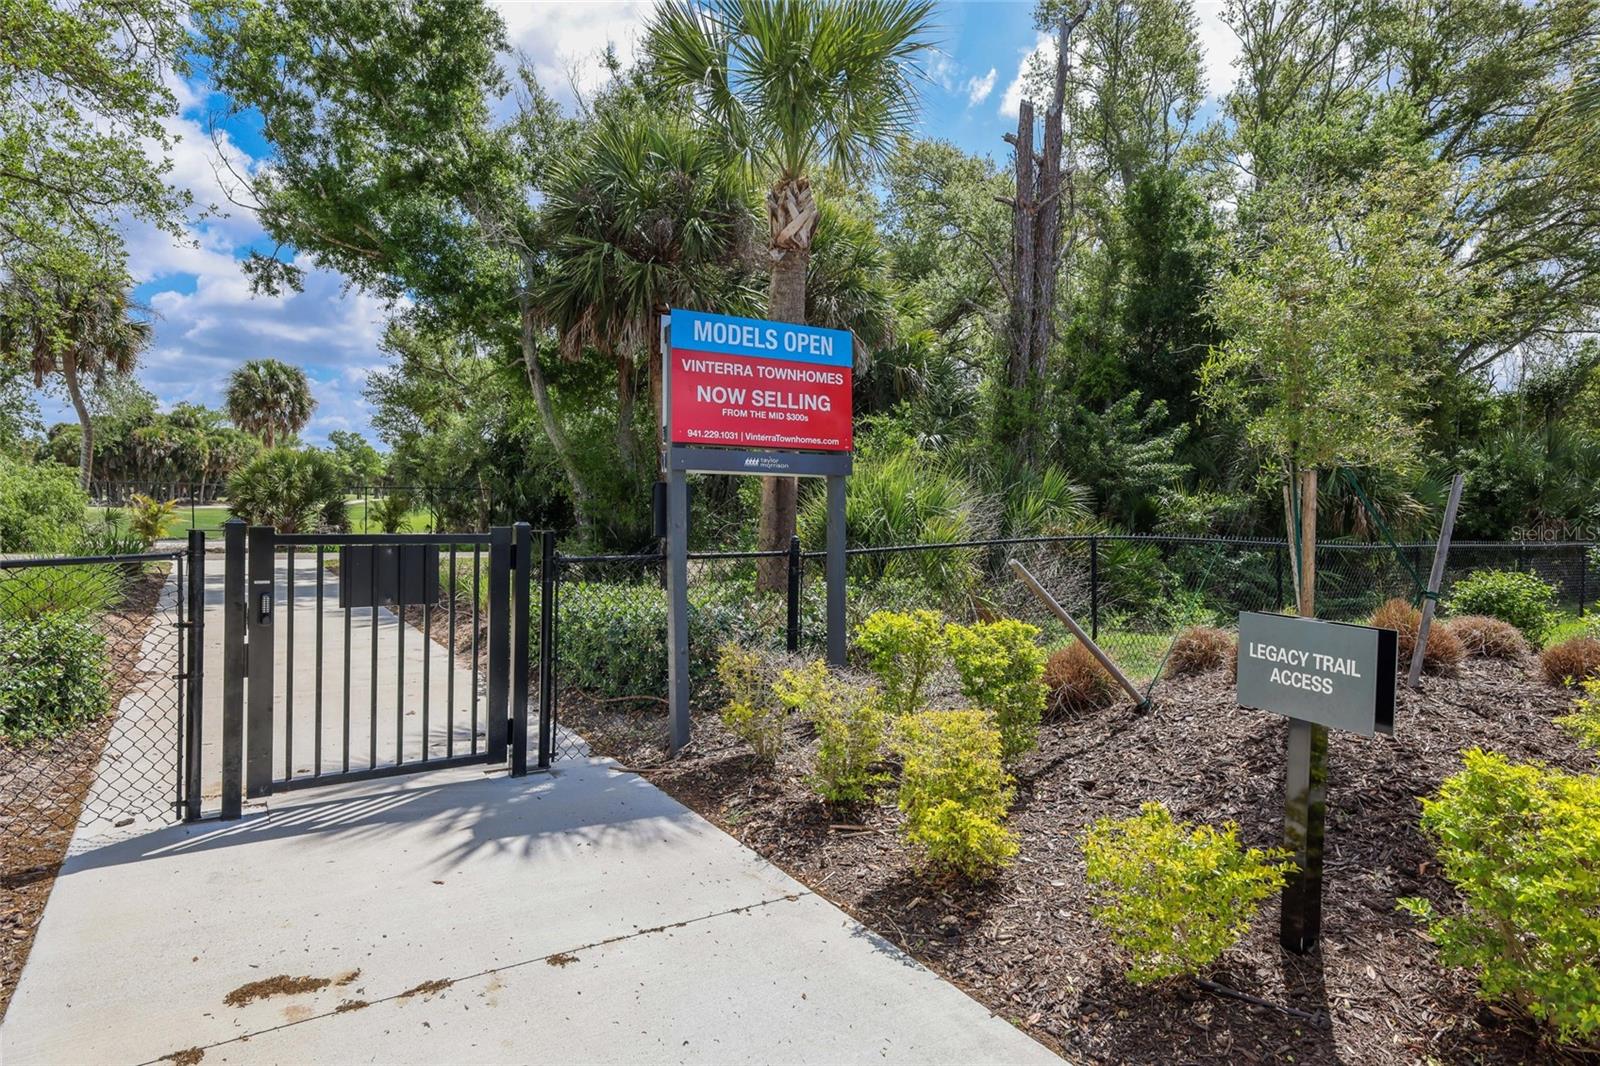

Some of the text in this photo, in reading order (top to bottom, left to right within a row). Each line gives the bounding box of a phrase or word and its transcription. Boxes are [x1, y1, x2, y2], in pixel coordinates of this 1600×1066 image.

[694, 320, 833, 356] MODELS OPEN
[681, 359, 844, 385] VINTERRA TOWNHOMES
[697, 385, 831, 411] NOW SELLING
[722, 408, 809, 422] FROM THE MID $300s
[687, 429, 840, 445] 941.229.1031 VinterraTownhomes.com
[1249, 642, 1361, 678] LEGACY TRAIL
[1269, 667, 1334, 695] ACCESS
